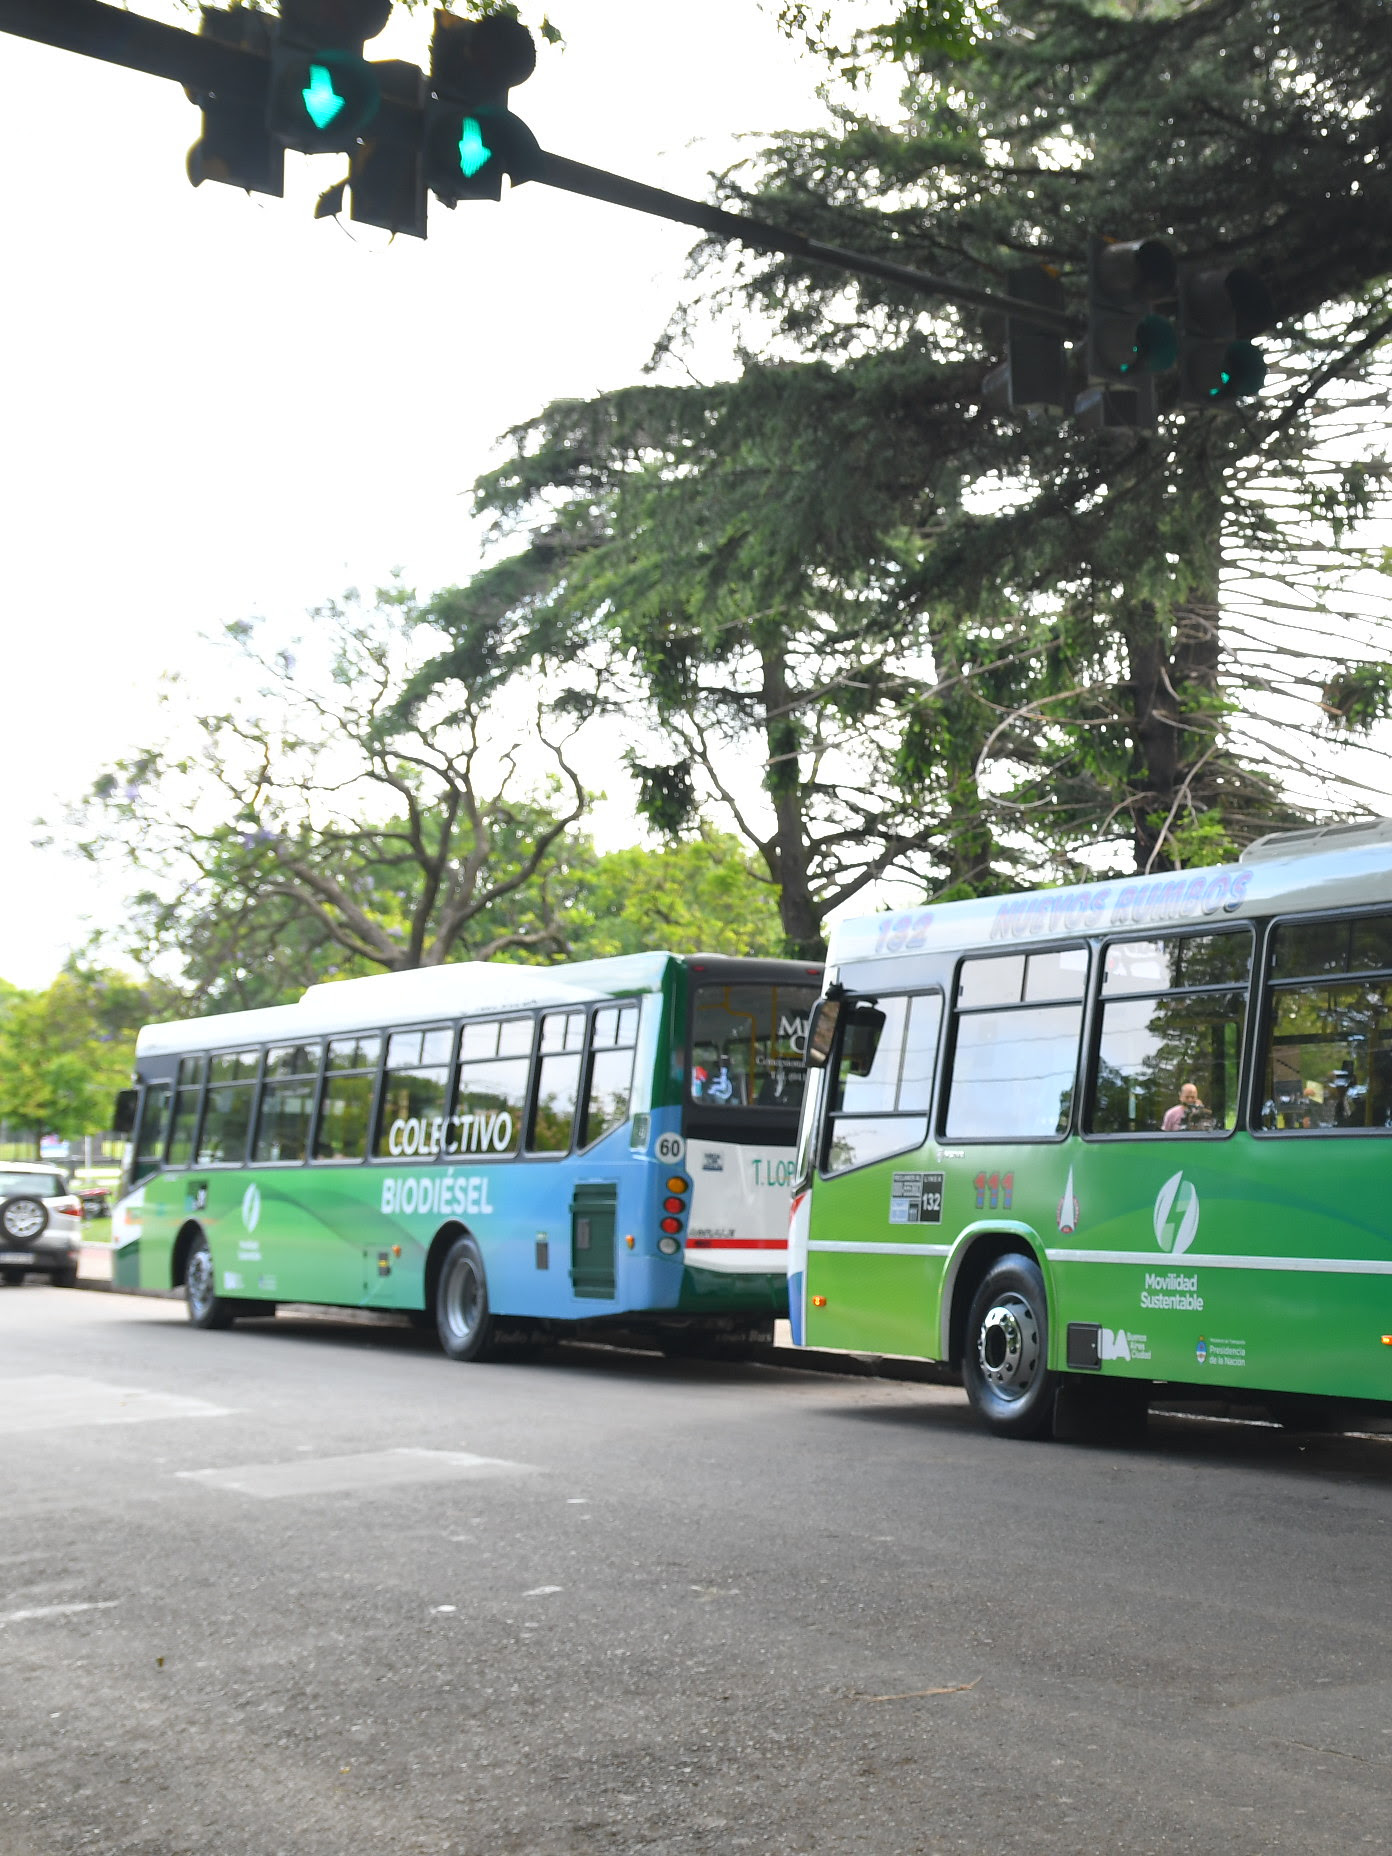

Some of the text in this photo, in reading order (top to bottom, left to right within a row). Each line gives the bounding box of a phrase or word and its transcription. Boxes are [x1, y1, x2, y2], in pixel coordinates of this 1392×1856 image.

[990, 870, 1254, 940] NUEVOS RUMBOS
[874, 911, 934, 953] 132
[388, 1110, 514, 1156] COLECTIVO
[660, 1139, 681, 1158] 60
[380, 1166, 493, 1215] BIODIÉSEL
[922, 1192, 941, 1211] 132
[974, 1171, 1014, 1210] 111
[1145, 1273, 1198, 1291] Movilidad
[1140, 1291, 1204, 1311] Sustentable
[1209, 1345, 1246, 1356] Presidencia
